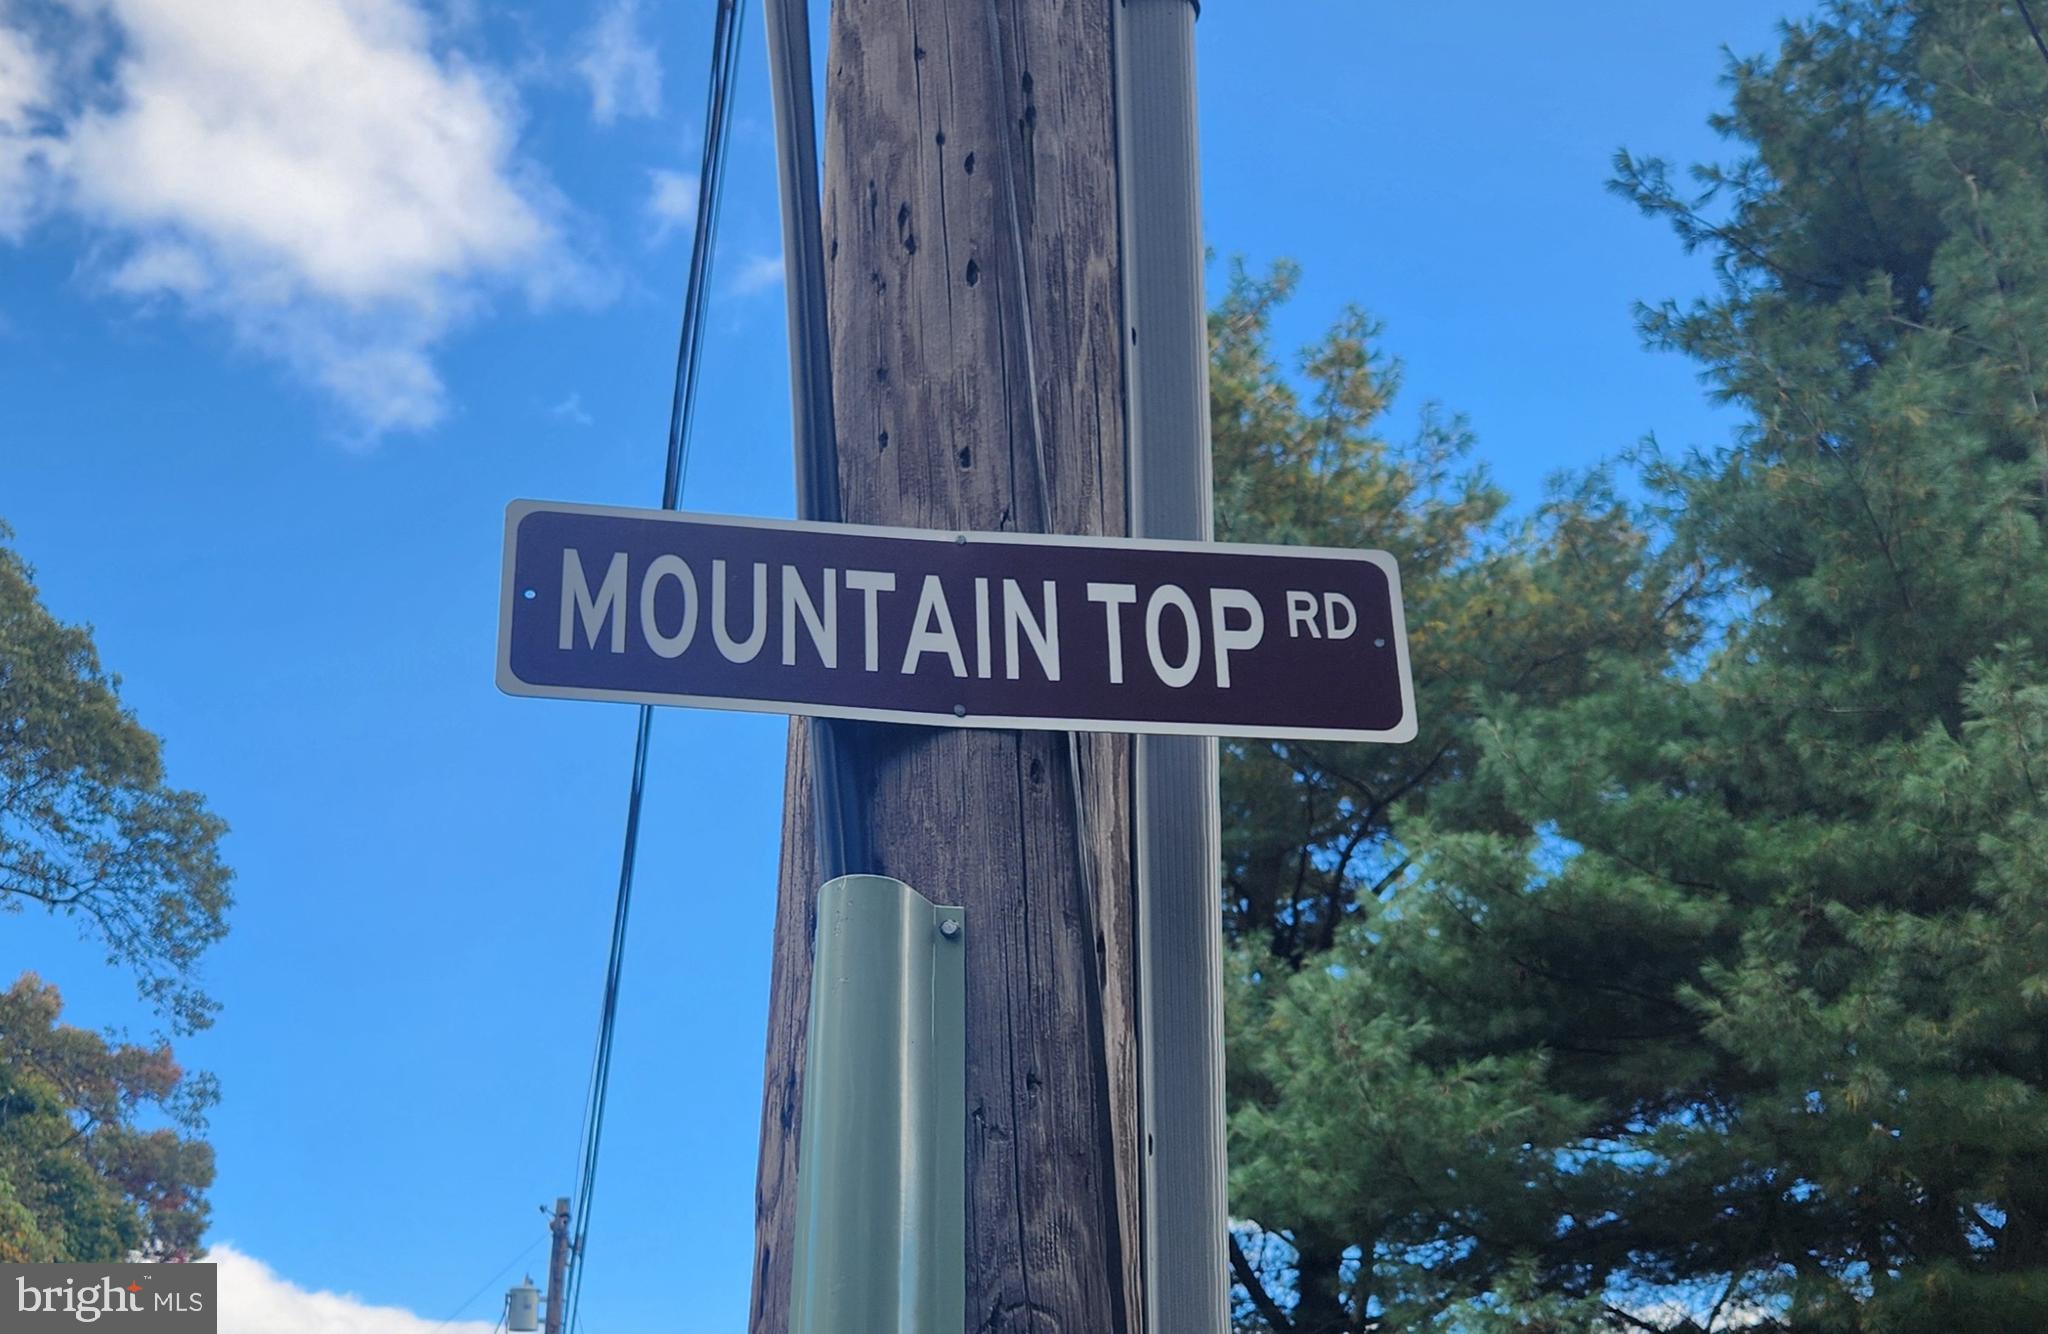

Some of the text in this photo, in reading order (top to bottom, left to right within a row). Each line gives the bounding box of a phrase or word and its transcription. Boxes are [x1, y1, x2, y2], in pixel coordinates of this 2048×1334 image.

[558, 548, 1358, 689] MOUNTAIN TOP RD
